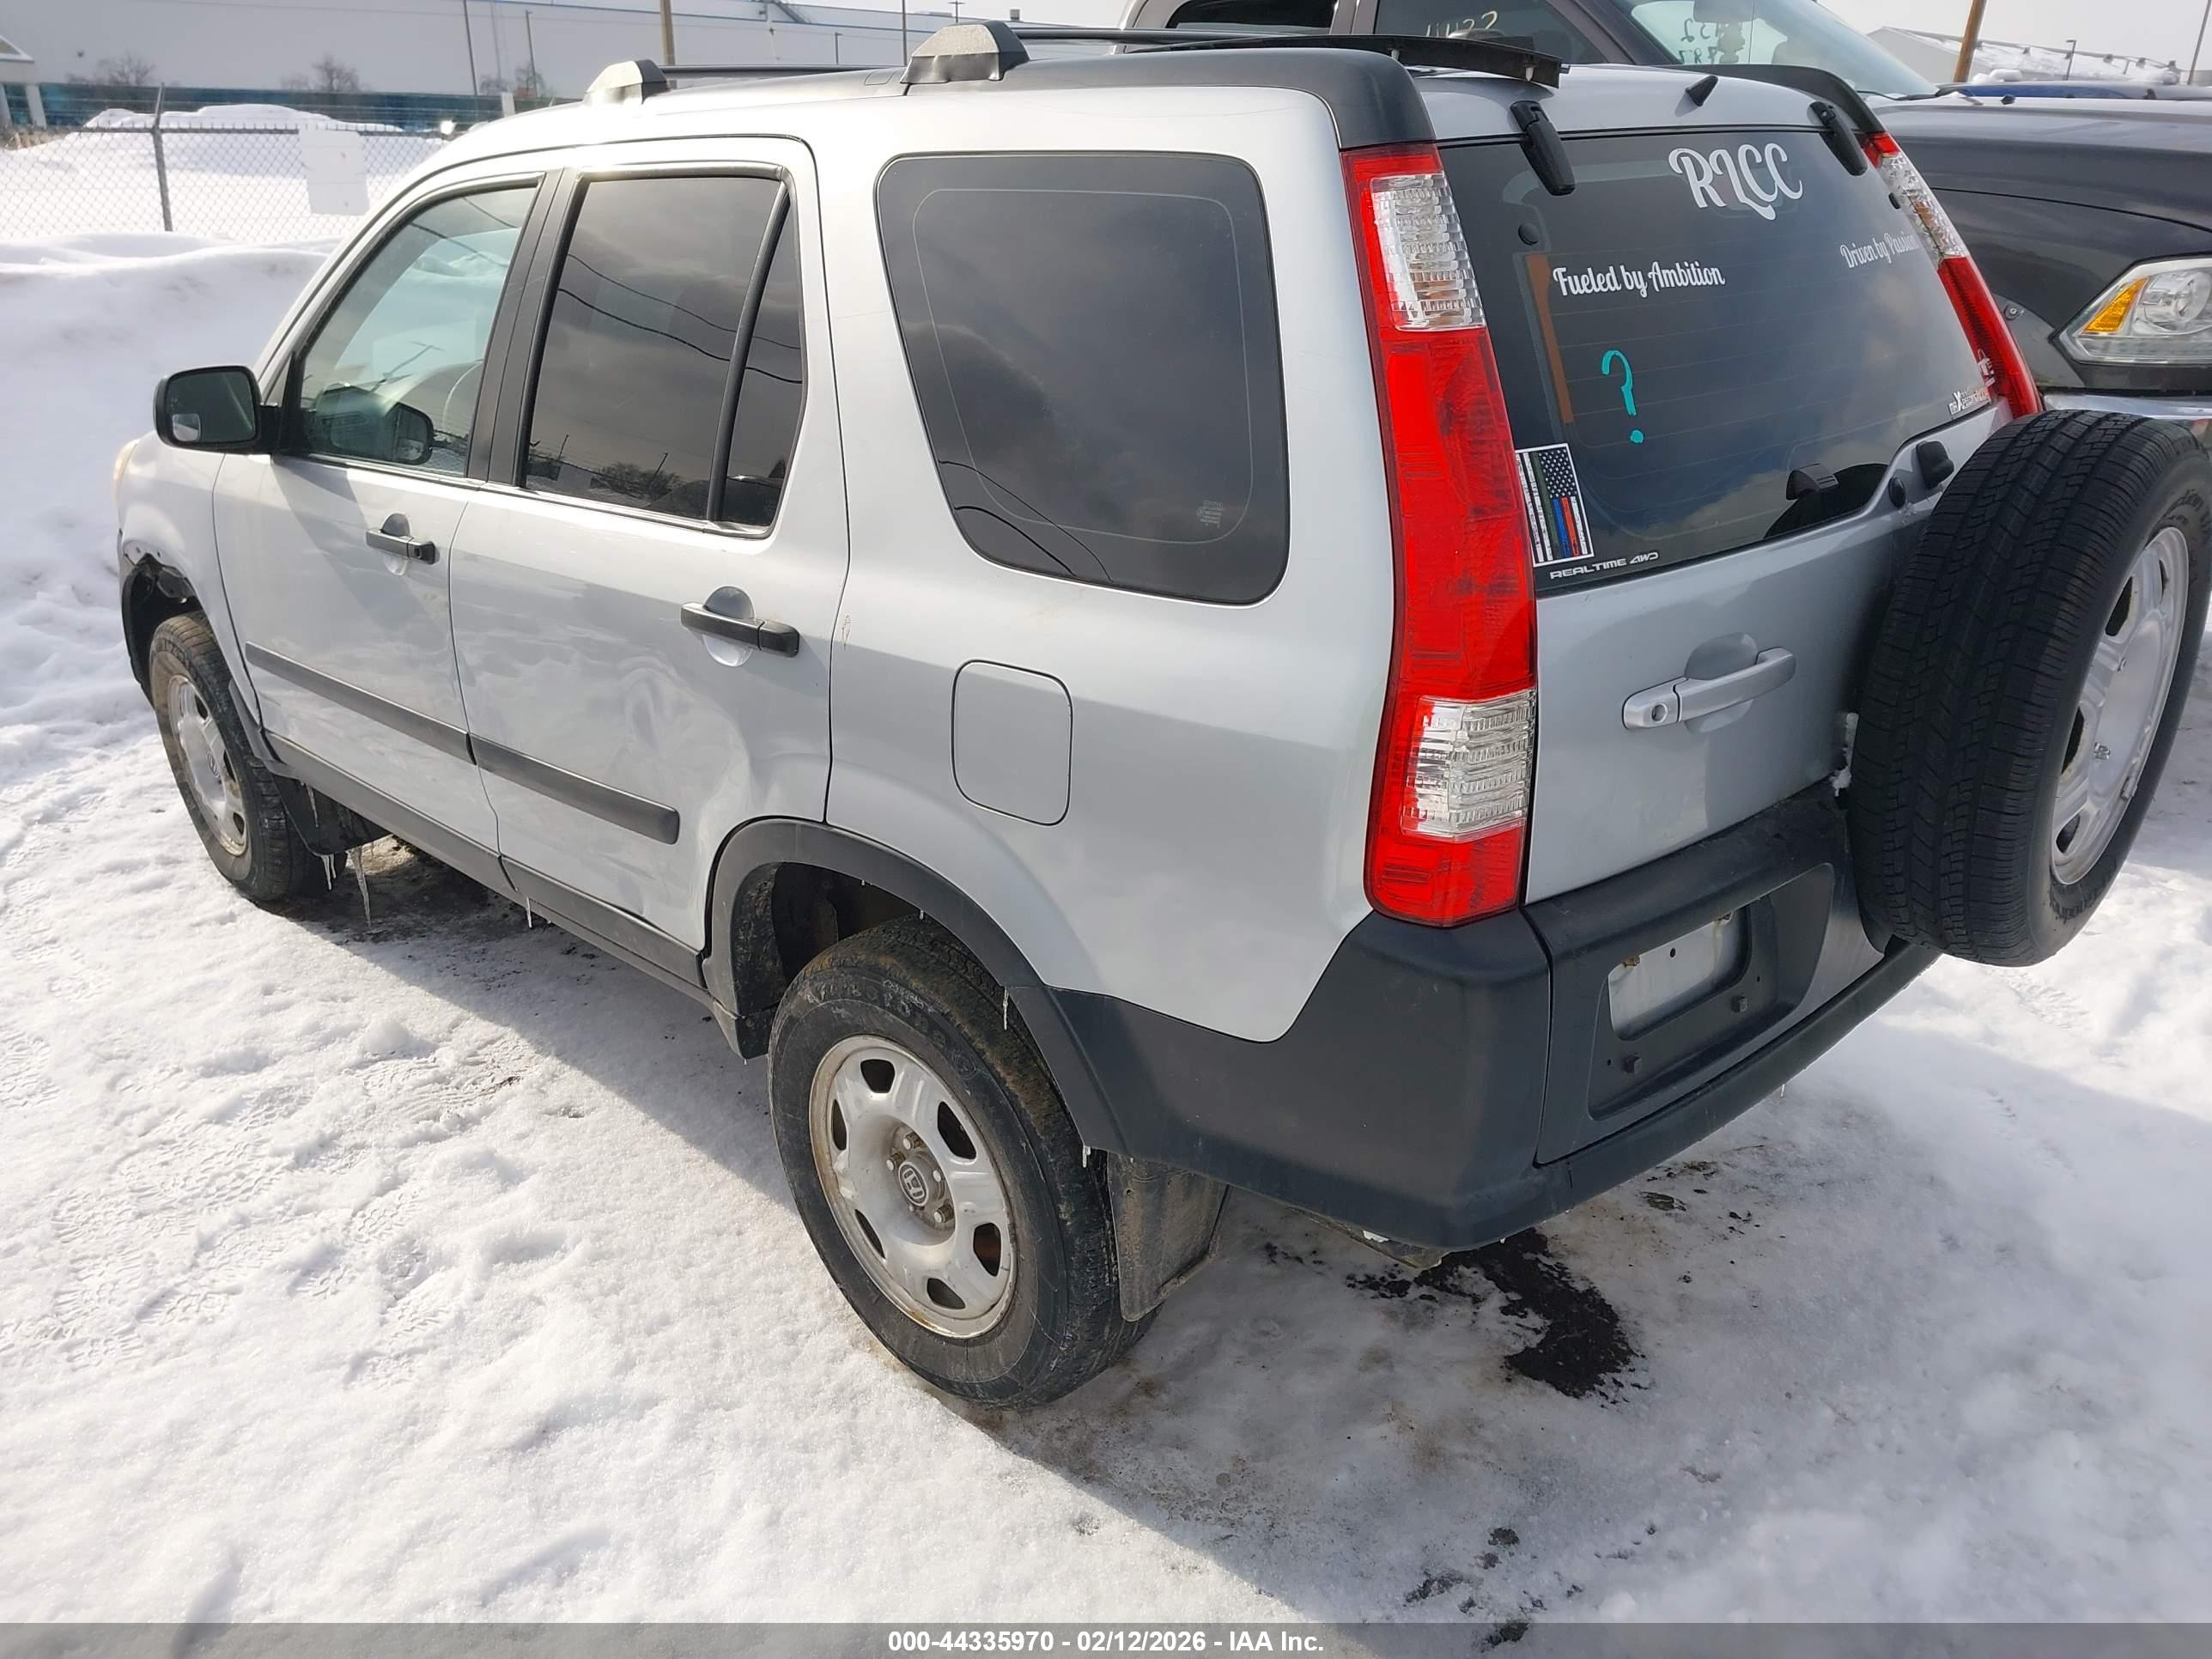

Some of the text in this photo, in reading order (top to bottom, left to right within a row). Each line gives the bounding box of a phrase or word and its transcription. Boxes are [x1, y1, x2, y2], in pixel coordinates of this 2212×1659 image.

[1668, 143, 1802, 220] RLCC
[1840, 242, 1878, 268] Driven
[1872, 237, 1892, 264] by
[1553, 260, 1726, 298] Fueled by Ambition
[1549, 551, 1659, 580] REALTIME 4WD
